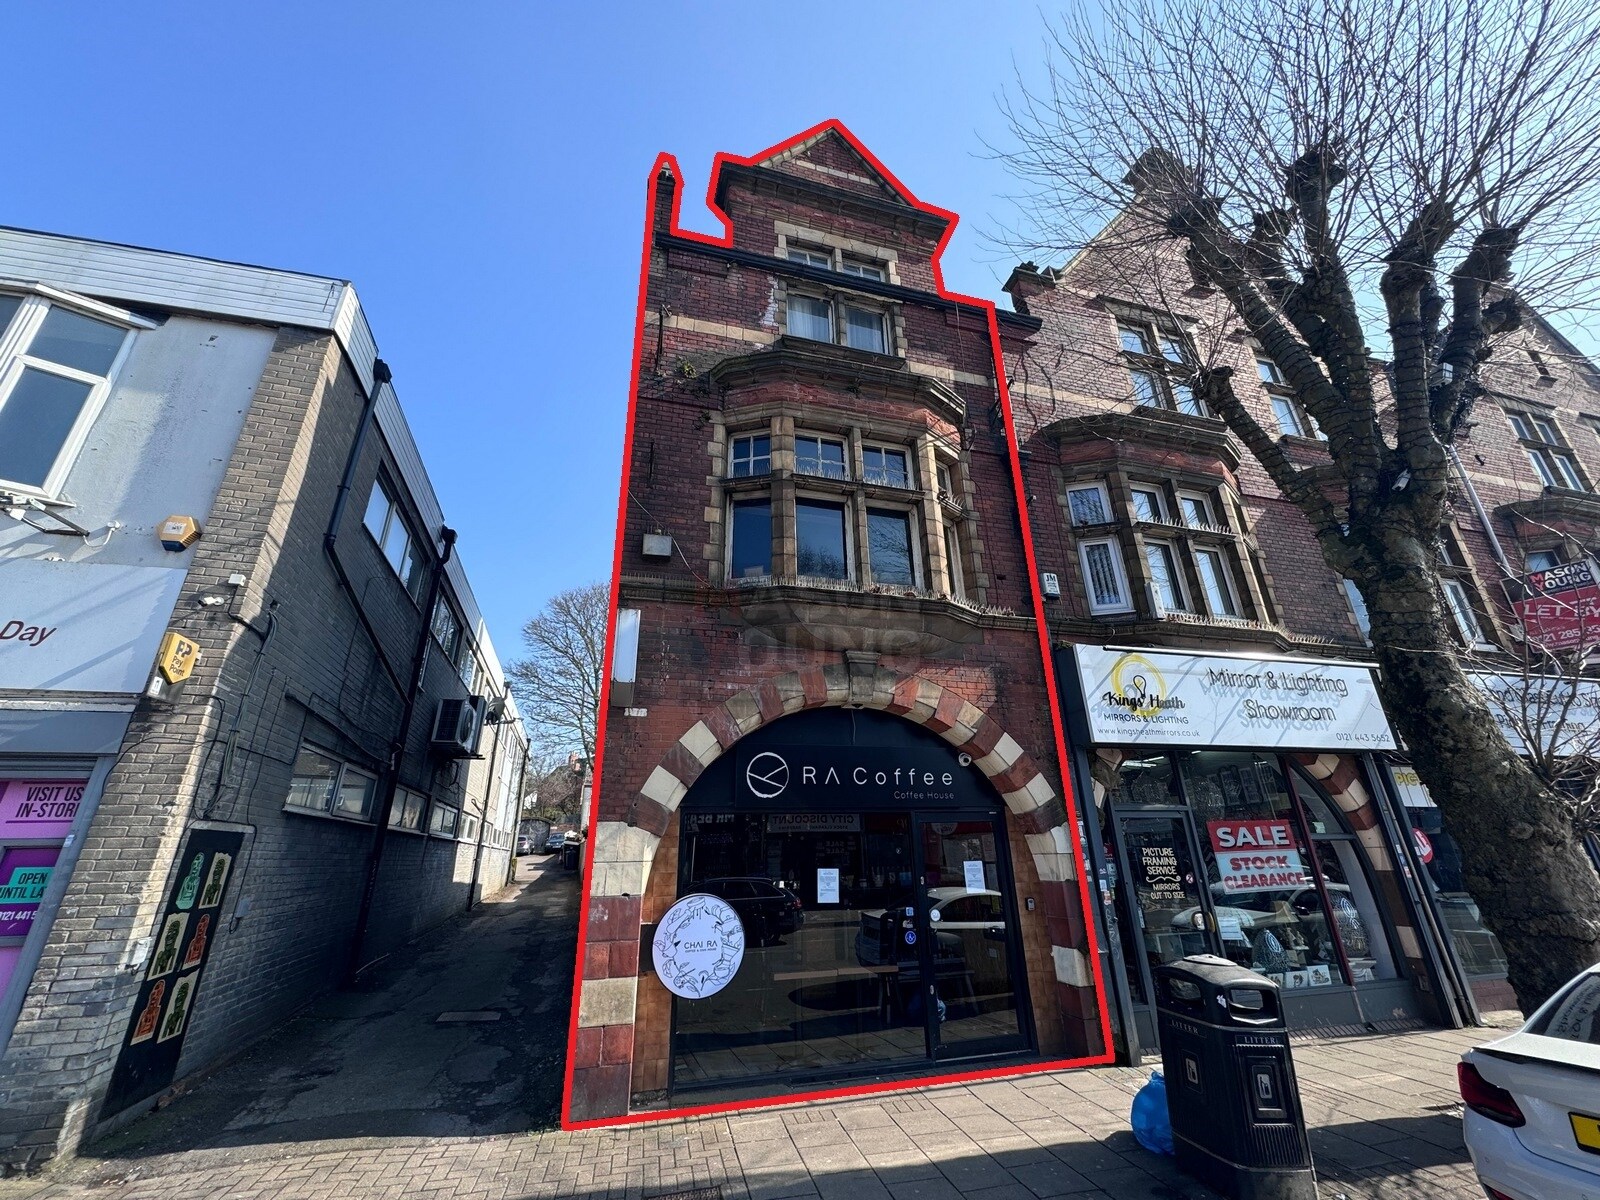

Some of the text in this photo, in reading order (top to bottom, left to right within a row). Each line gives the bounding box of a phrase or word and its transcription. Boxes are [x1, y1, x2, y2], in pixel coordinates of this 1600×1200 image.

[1529, 561, 1588, 583] MASON
[1534, 572, 1592, 591] YOUNG
[1524, 604, 1562, 617] LET
[0, 620, 57, 647] Day
[1557, 628, 1581, 640] 285
[172, 655, 184, 668] Pay
[169, 664, 185, 677] Point
[1208, 667, 1349, 698] Mirror & Lighting
[1102, 691, 1186, 712] Kings Heath
[1244, 698, 1337, 722] Showroom
[1103, 713, 1189, 724] MIRRORS & LIGHTING
[1097, 728, 1201, 738] www.kingsheathmirrors.co.uk
[1335, 732, 1391, 742] 0121 443 5652
[853, 767, 953, 785] Coffee
[26, 787, 85, 802] VISIT US
[894, 790, 955, 800] Coffee House
[1216, 825, 1291, 848] SALE
[1141, 847, 1175, 857] PICTURE
[1142, 857, 1178, 866] FRAMING
[1229, 855, 1292, 871] STOCK
[1146, 866, 1178, 875] SERVICE
[18, 872, 48, 885] OPEN
[1224, 872, 1305, 890] CLEARANCE
[0, 886, 27, 900] UNTIL
[1152, 882, 1181, 891] MIRRORS
[1150, 891, 1186, 900] CUT TO SIZE
[15, 910, 30, 920] 441
[683, 940, 718, 950] CHAI RA
[1171, 1020, 1199, 1035] LITTER
[1244, 1036, 1276, 1044] LITTER
